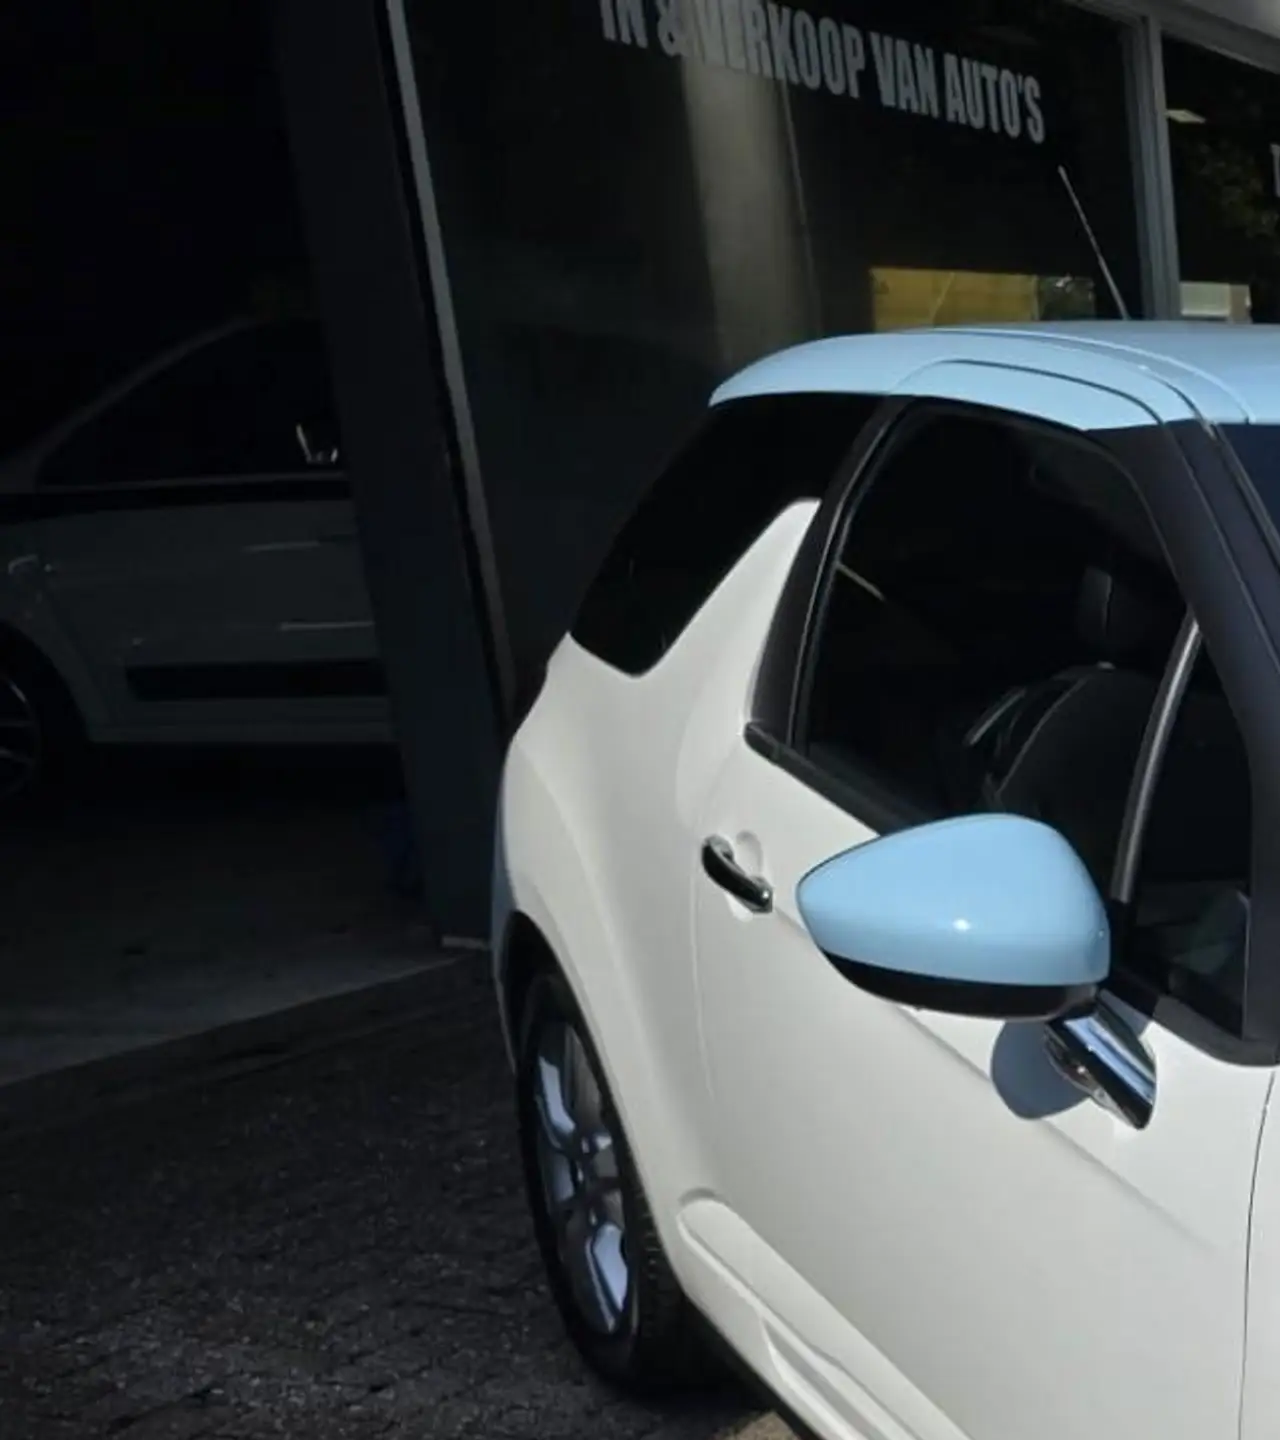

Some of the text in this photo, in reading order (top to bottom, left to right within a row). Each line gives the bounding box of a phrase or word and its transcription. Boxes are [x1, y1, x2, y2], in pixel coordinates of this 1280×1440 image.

[695, 0, 866, 99] VERKOOP
[869, 31, 940, 119] VAN
[943, 52, 1046, 144] AUTO'S
